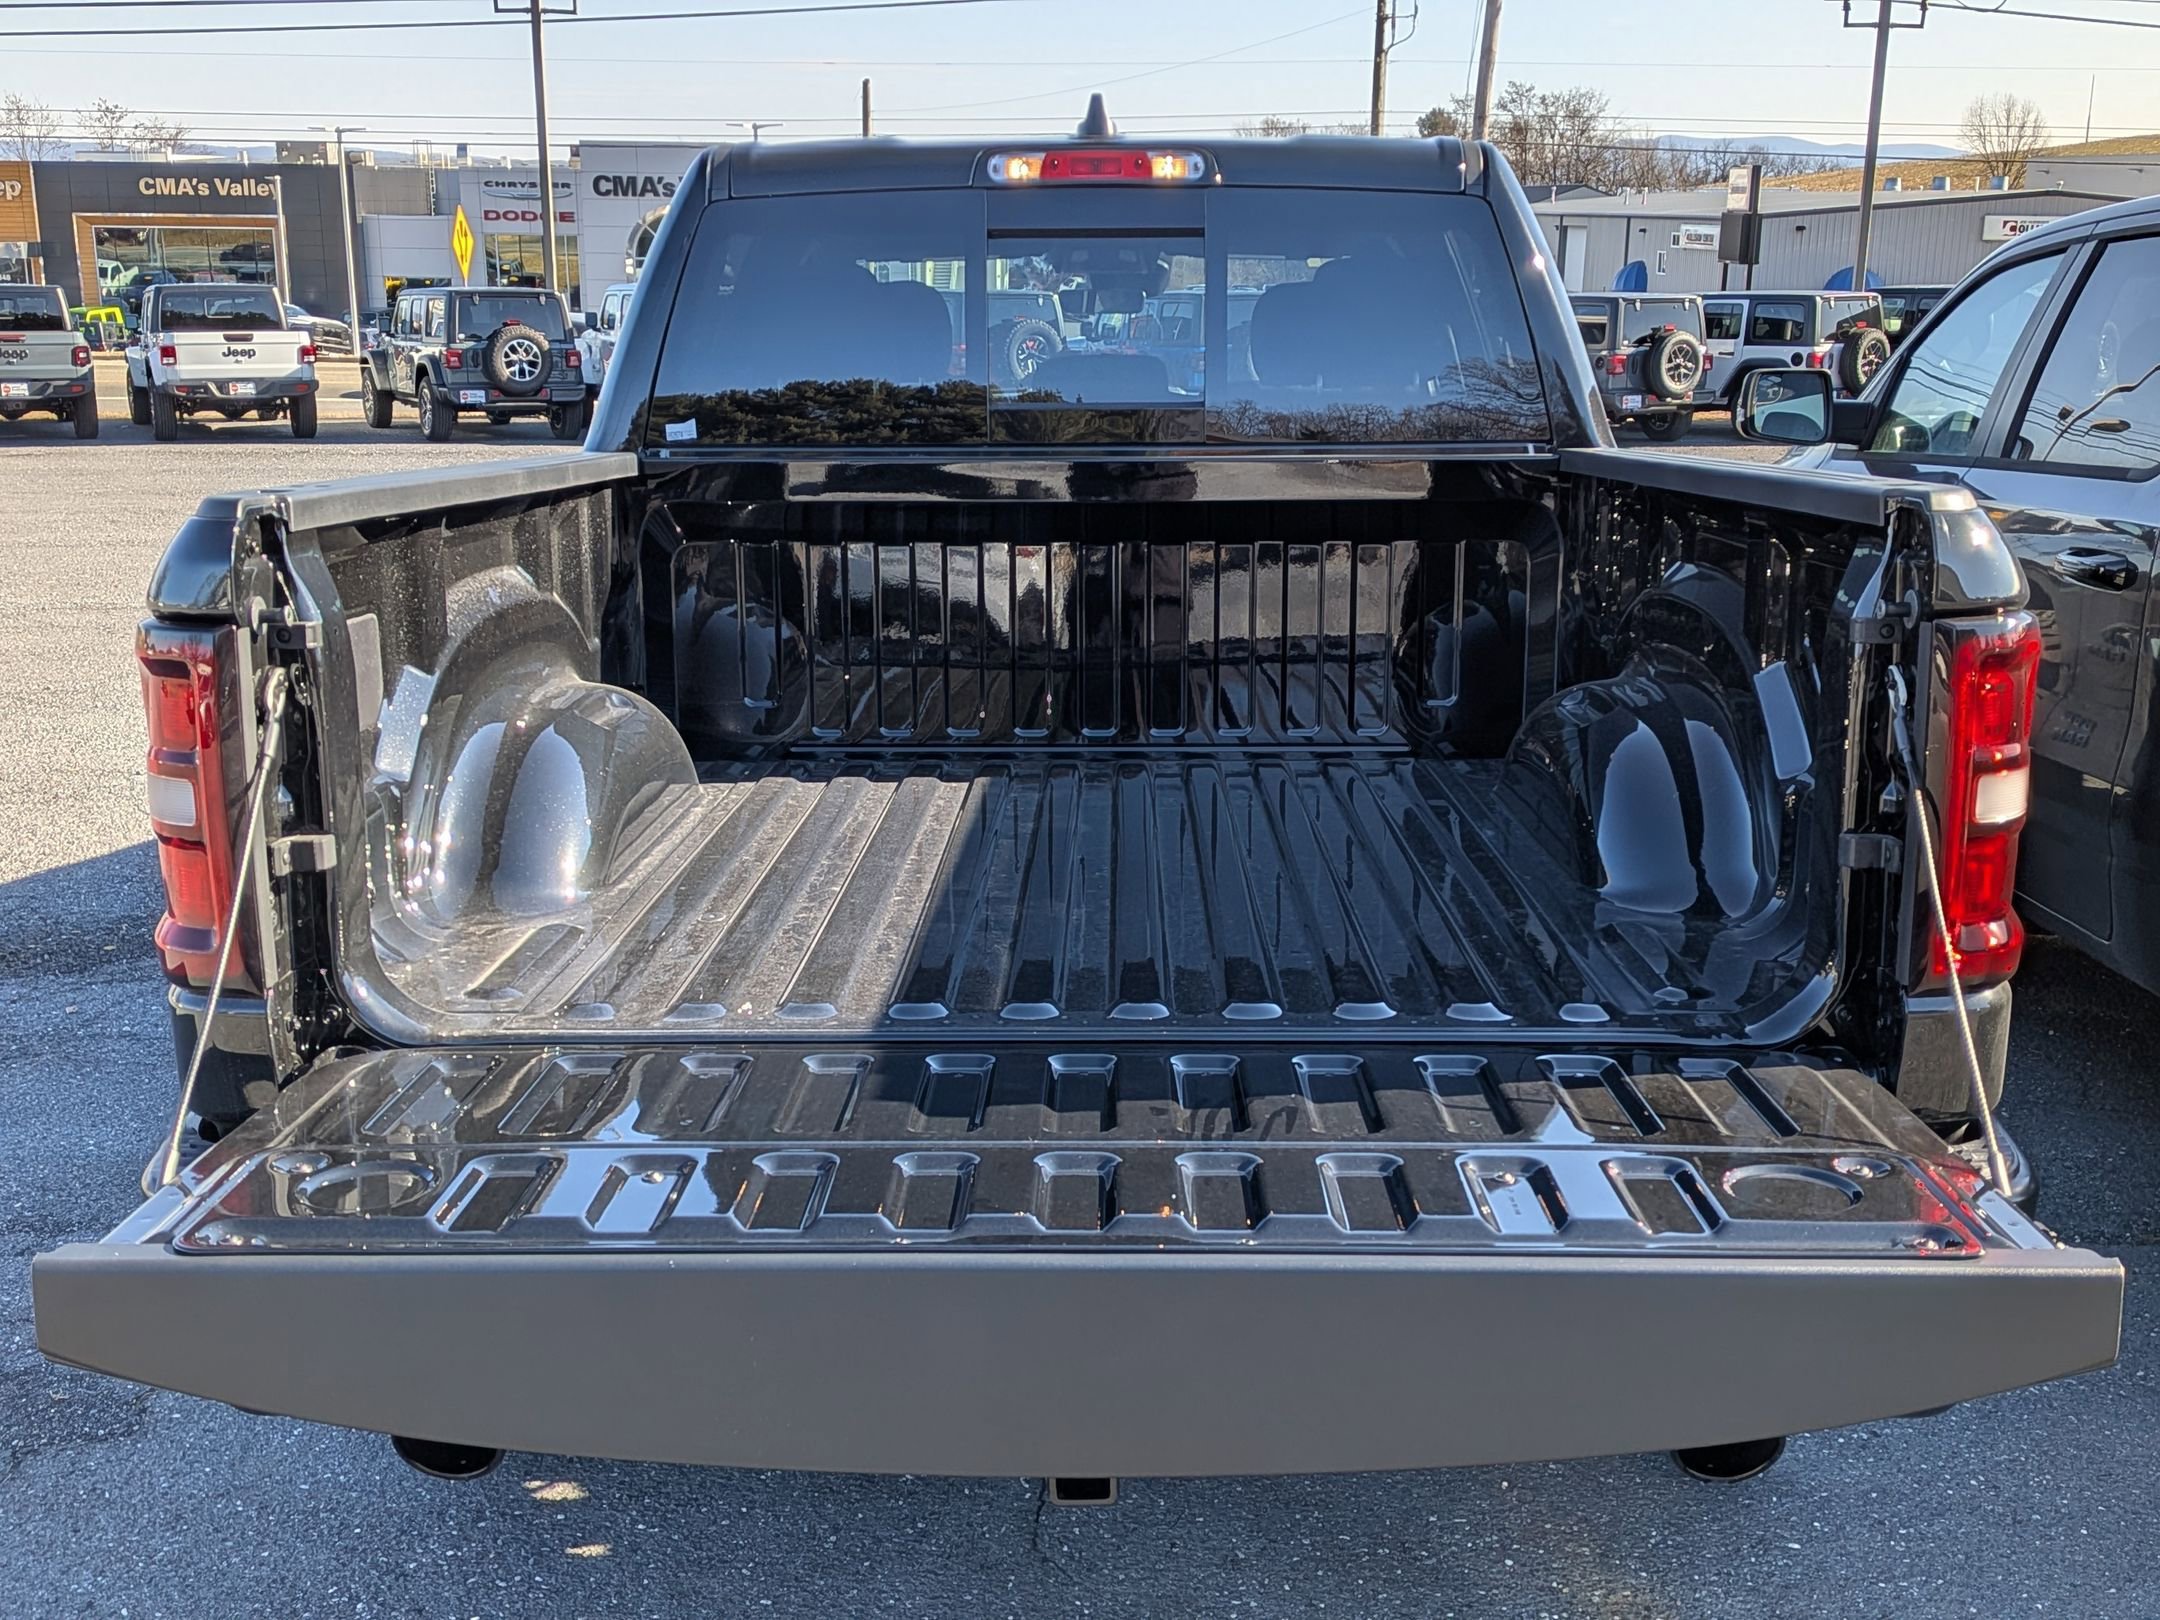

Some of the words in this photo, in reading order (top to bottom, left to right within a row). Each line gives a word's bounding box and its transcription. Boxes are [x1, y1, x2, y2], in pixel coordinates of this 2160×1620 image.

[138, 177, 210, 196] CMA's
[483, 180, 571, 189] CHRYSER
[592, 174, 676, 198] CMA's
[0, 347, 28, 360] eep
[221, 346, 256, 359] Jeep
